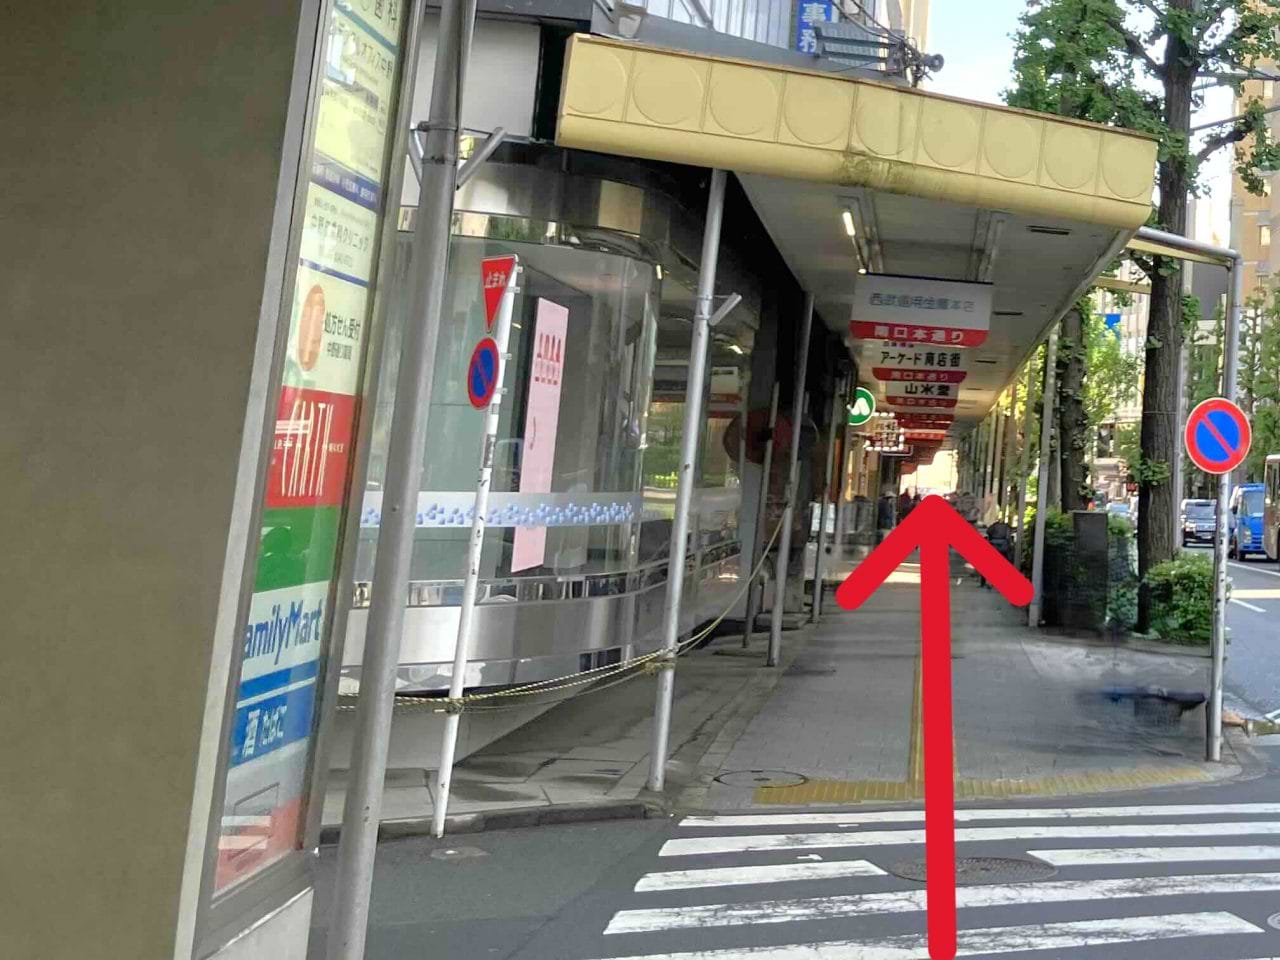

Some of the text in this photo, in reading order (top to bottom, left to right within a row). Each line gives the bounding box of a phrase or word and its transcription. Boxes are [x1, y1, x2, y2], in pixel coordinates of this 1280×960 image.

[874, 325, 964, 343] 南口本通り
[880, 351, 961, 368] アーケード商店街
